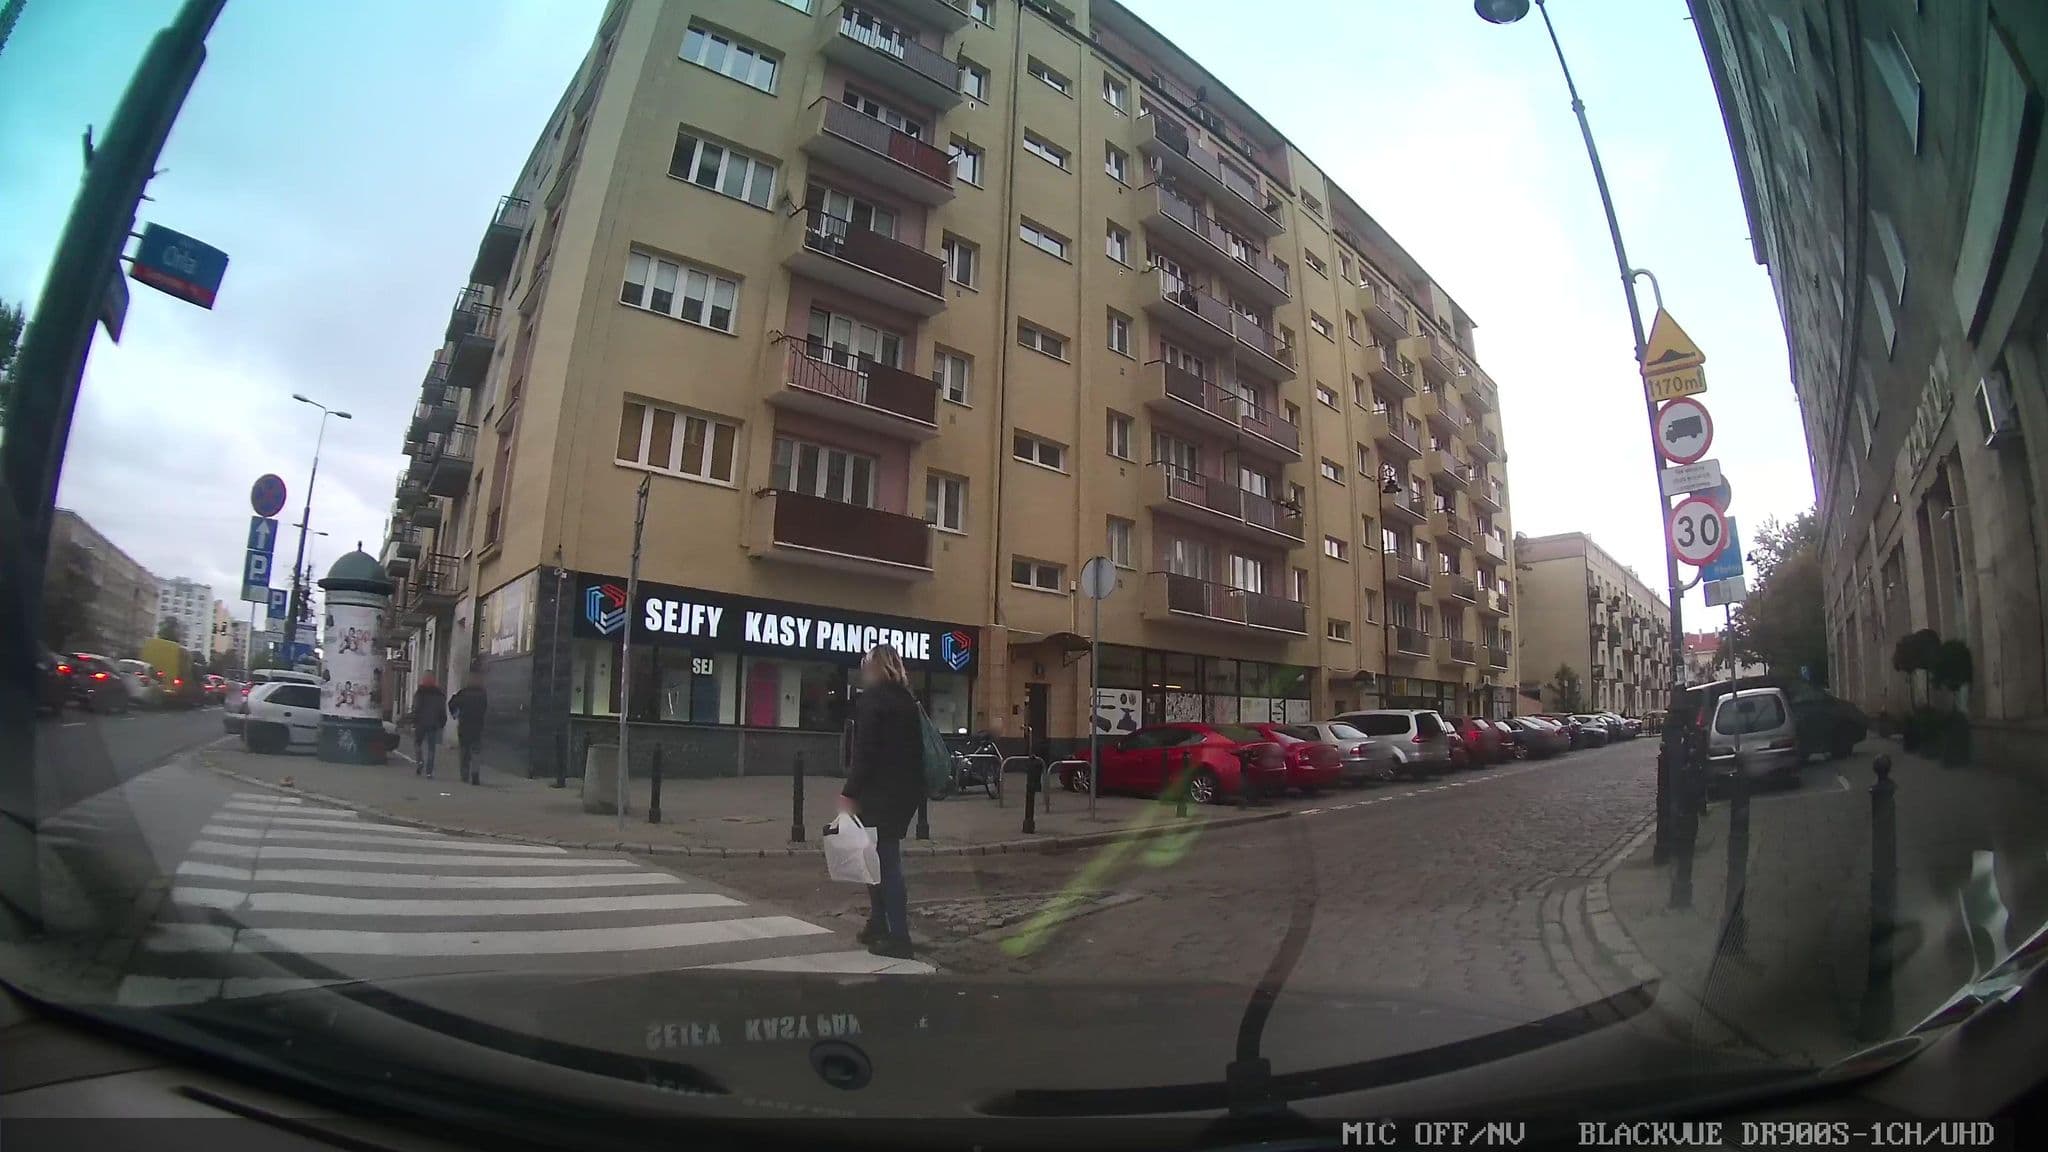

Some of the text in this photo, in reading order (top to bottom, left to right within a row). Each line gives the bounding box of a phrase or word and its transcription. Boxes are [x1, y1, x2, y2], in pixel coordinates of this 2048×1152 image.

[1677, 513, 1720, 548] 30
[249, 554, 268, 580] P
[271, 591, 283, 609] P
[645, 596, 724, 639] SEJFY
[745, 610, 812, 649] KASY
